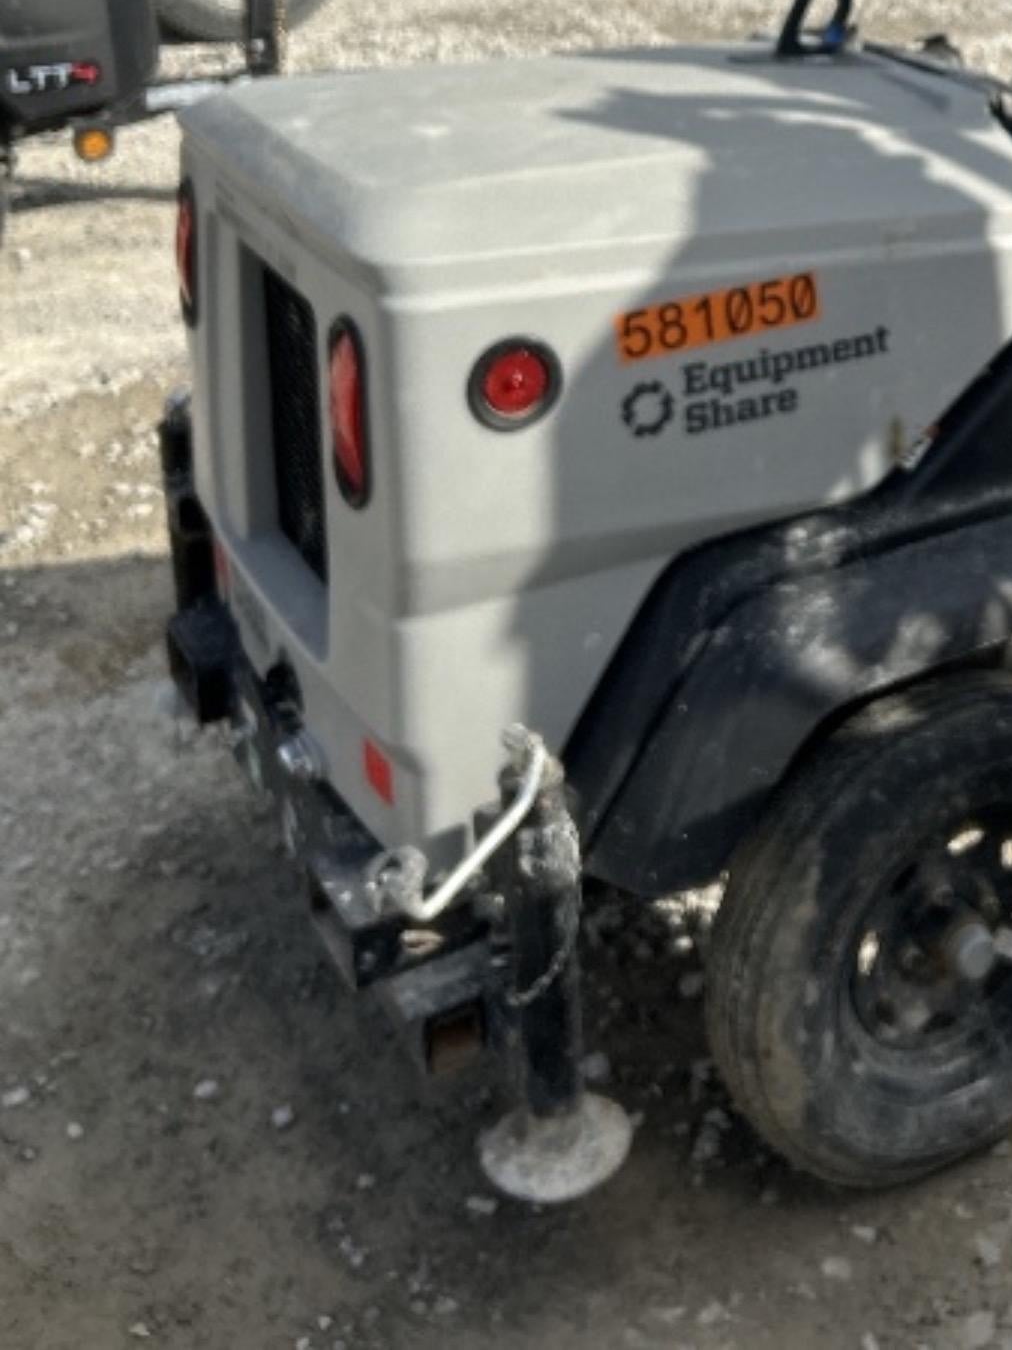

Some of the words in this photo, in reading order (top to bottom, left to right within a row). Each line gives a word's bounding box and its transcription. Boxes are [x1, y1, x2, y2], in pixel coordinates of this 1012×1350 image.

[622, 272, 818, 359] 581050
[682, 323, 890, 396] Equipment
[685, 387, 799, 436] Share
